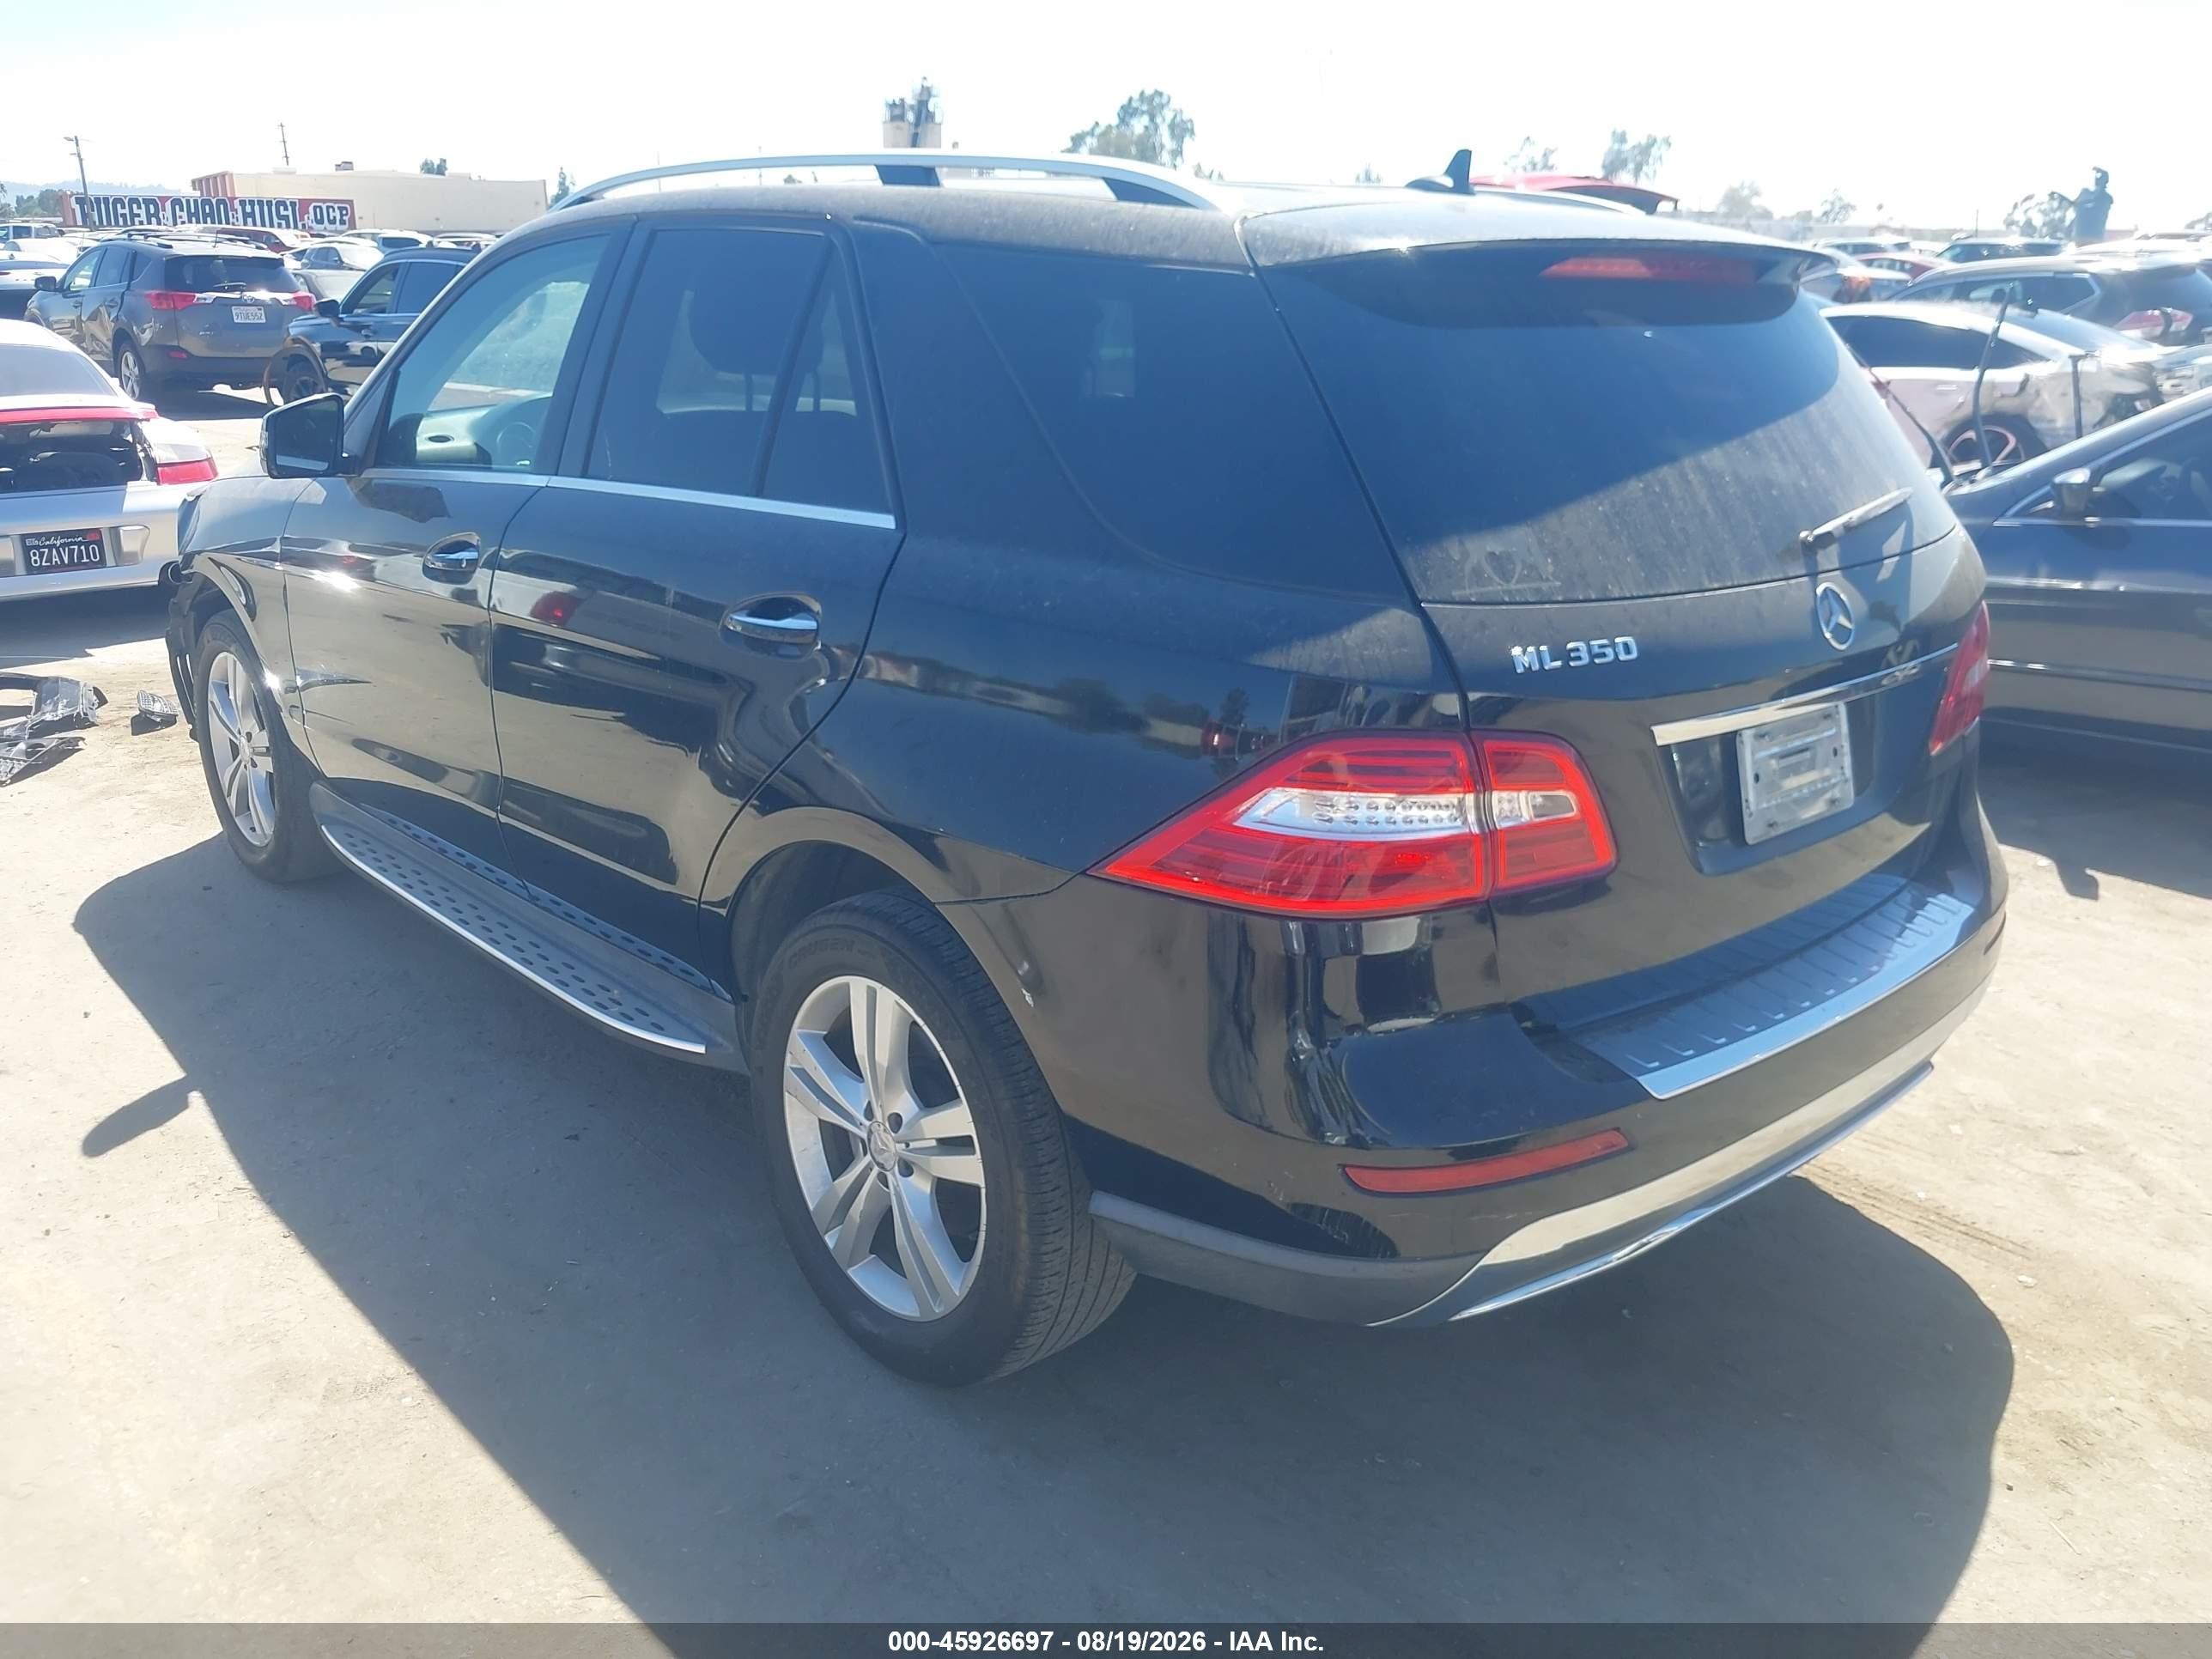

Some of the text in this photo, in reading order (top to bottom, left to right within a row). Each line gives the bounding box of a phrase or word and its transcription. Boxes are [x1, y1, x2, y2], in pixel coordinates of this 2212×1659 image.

[39, 535, 87, 547] California
[29, 544, 100, 567] 8ZAV710
[1510, 635, 1639, 674] ML 350
